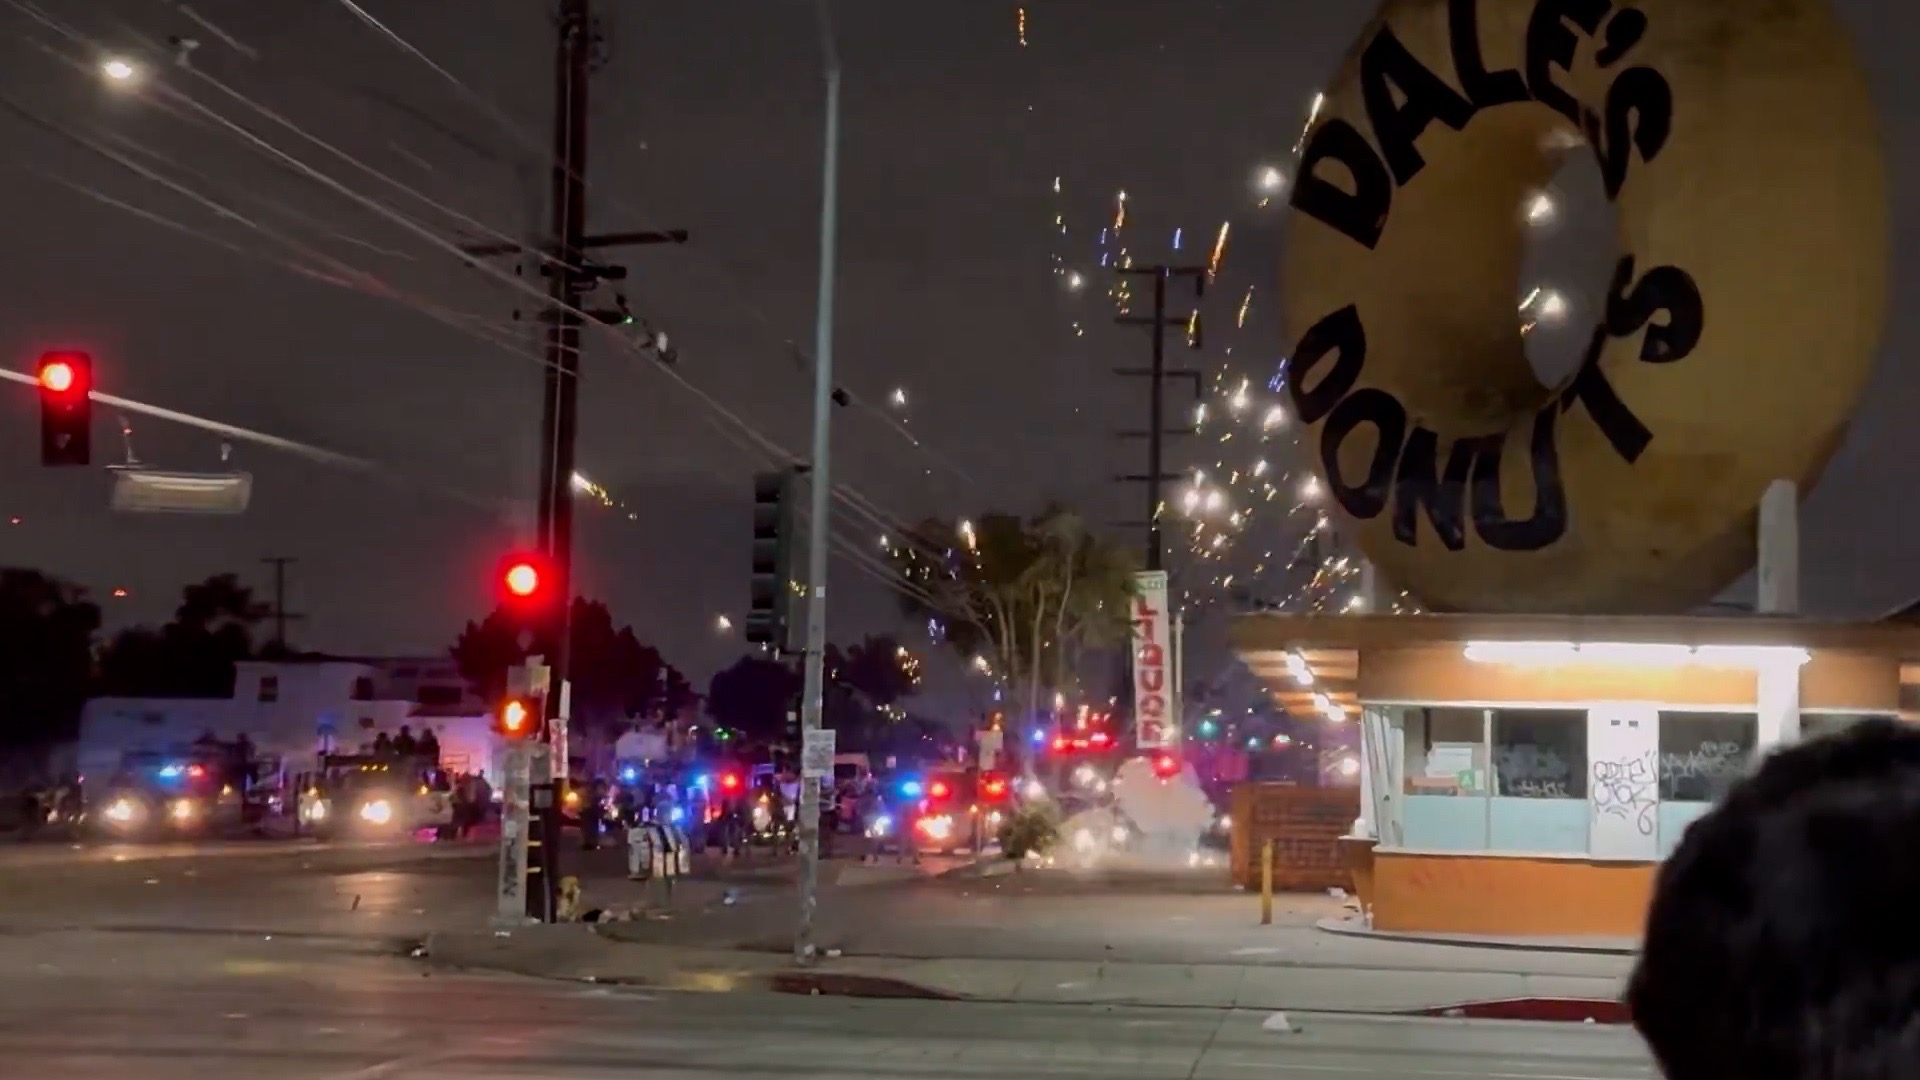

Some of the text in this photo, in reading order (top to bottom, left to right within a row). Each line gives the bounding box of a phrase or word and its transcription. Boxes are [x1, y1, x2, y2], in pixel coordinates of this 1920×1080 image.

[1289, 0, 1672, 249] DALE'S
[1288, 254, 1704, 551] DONUTS
[1137, 594, 1164, 742] LIQUOR
